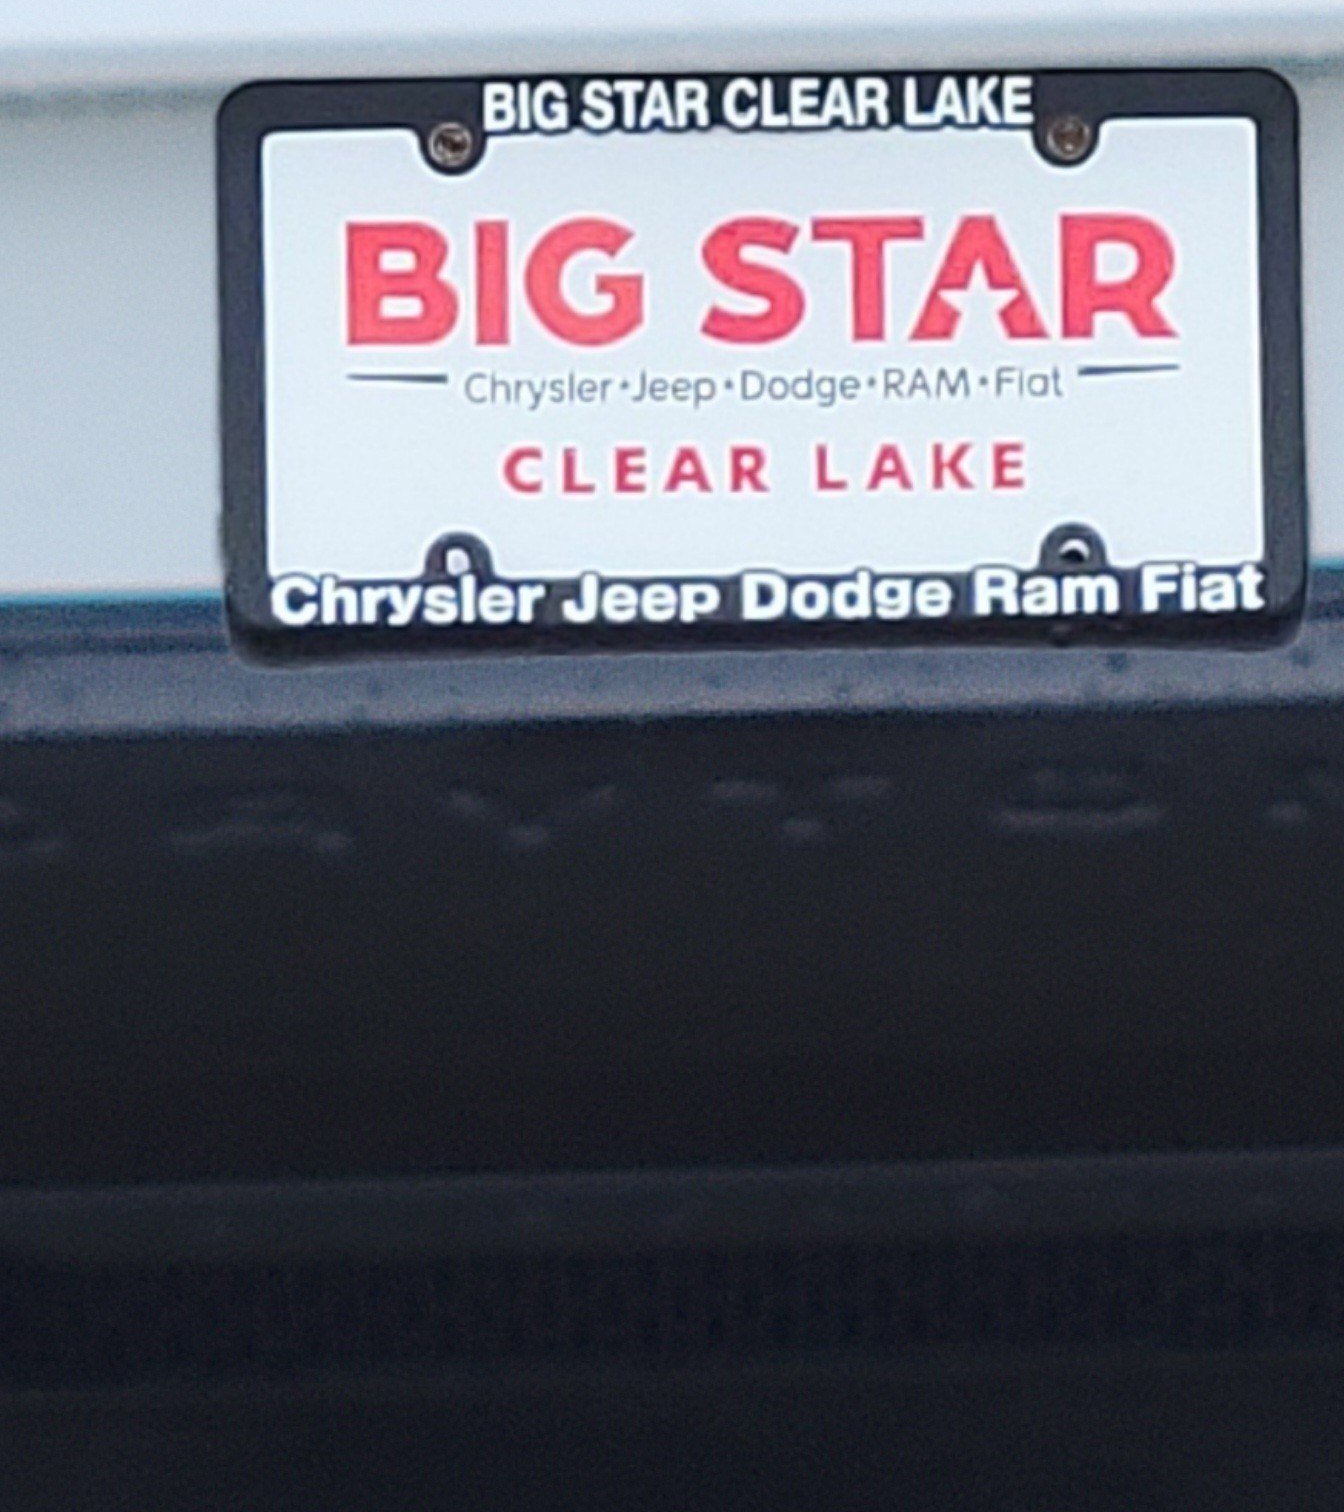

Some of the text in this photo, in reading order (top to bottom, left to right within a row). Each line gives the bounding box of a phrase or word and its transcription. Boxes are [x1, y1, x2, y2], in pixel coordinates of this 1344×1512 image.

[482, 76, 1035, 131] BIG STAR CLEAR LAKE
[345, 212, 1177, 348] BIG STAR
[464, 366, 1064, 409] Chrysler Jeep Dodge RAM Fiat
[503, 442, 1026, 493] CLEAR LAKE
[270, 562, 1266, 626] Chrysler Jeep Dodge Ram Fiat
